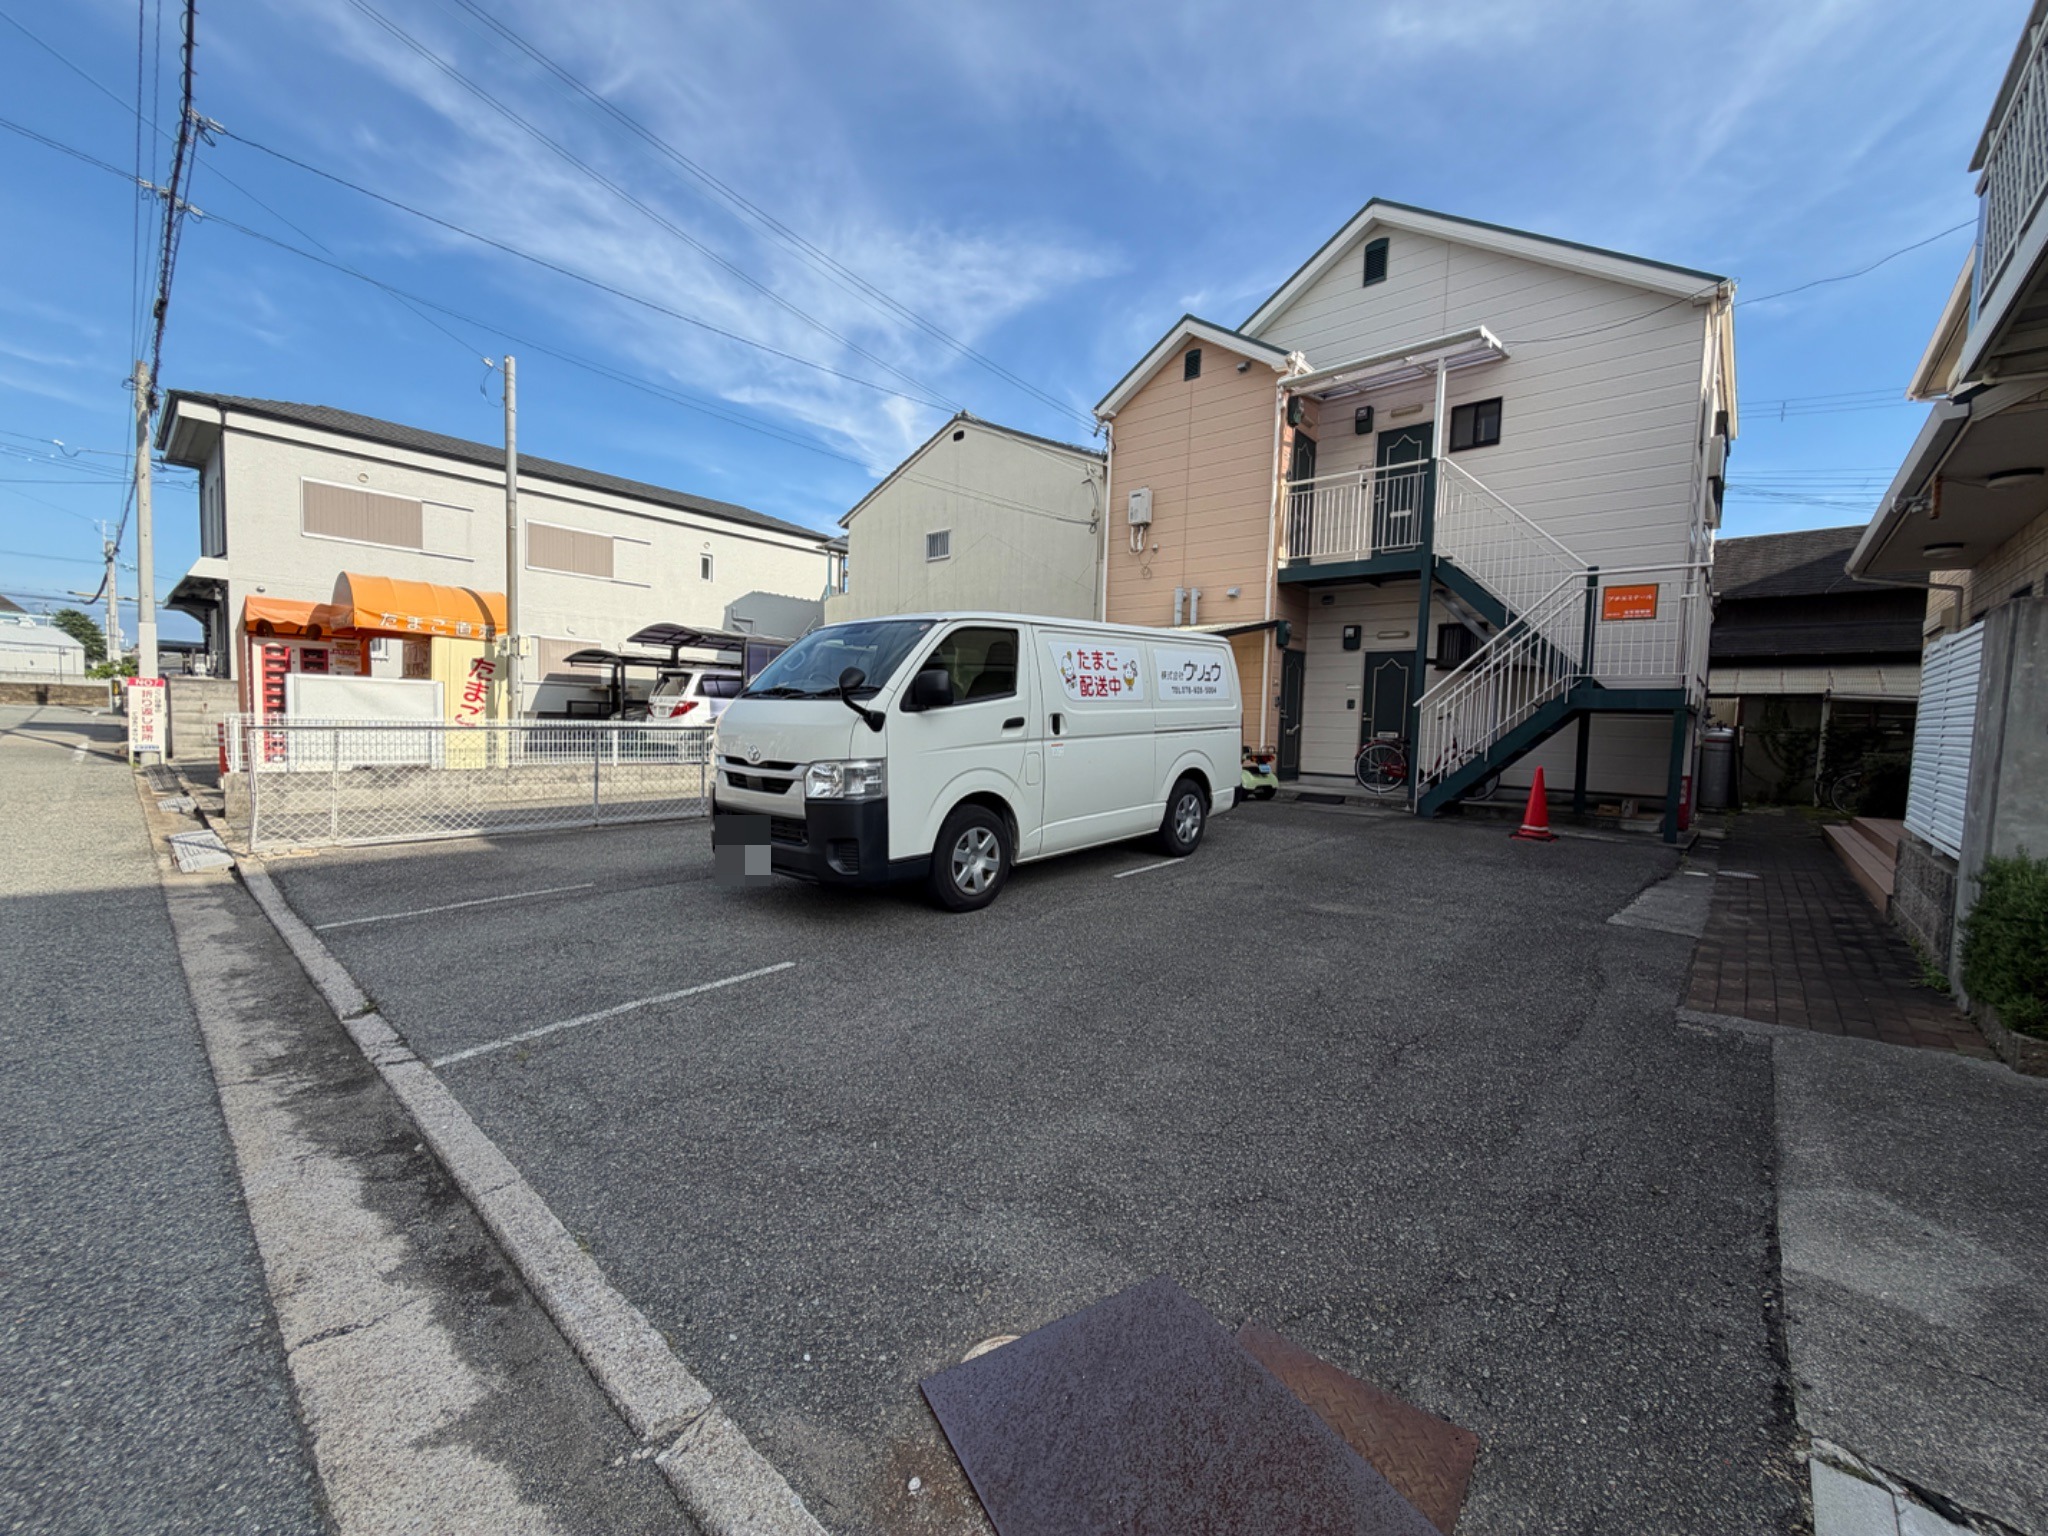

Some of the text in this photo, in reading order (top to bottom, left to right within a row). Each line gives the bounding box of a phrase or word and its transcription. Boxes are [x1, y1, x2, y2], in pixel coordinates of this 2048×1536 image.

[1077, 649, 1118, 672] たまご
[454, 657, 497, 727] たまご
[1079, 676, 1121, 697] 配送中
